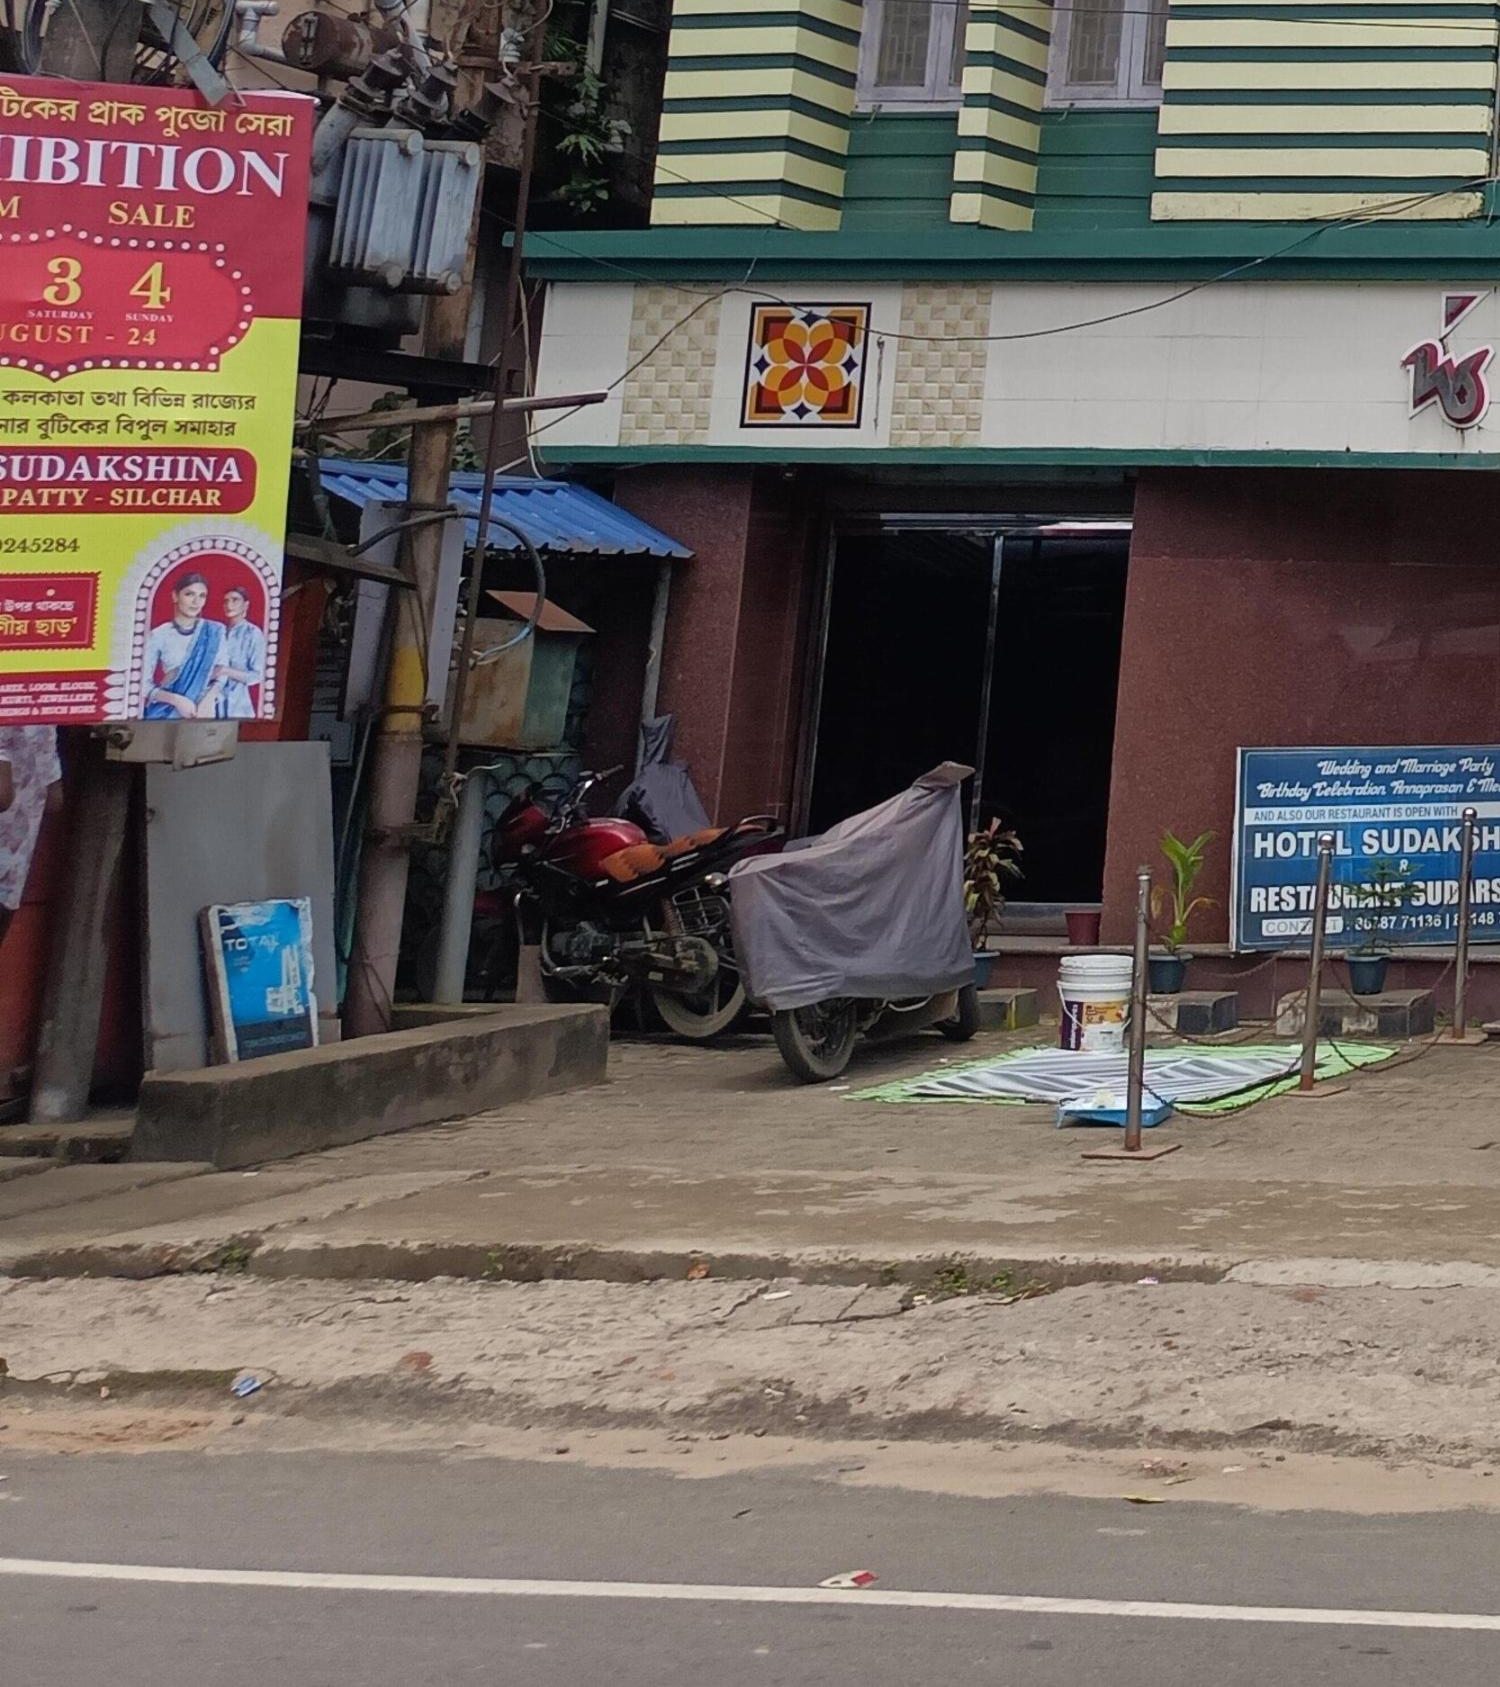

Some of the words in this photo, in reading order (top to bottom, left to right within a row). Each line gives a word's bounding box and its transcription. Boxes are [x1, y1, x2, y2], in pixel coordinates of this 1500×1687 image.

[88, 100, 146, 126] প্রাক
[155, 107, 227, 138] পুজো
[235, 112, 294, 137] সেরা
[0, 134, 290, 198] IBITION
[108, 201, 195, 229] SALE
[43, 257, 82, 306] 3
[129, 261, 171, 310] 4
[28, 309, 94, 320] SATURDAY
[125, 313, 174, 323] SUNDAY
[127, 327, 157, 346] 24
[3, 390, 84, 407] কলকাতা
[91, 391, 127, 407] তথা
[133, 387, 186, 409] বিভিন্ন
[192, 393, 256, 410] রাজ্যের
[37, 413, 110, 440] বুটিকের
[116, 414, 167, 441] বিপুল
[174, 420, 237, 437] সমাহার
[1, 488, 88, 506] PATTY
[110, 488, 221, 507] SILCHAR
[0, 537, 80, 553] 245284
[1317, 759, 1372, 779] Wedding
[1375, 758, 1401, 774] and
[1400, 758, 1456, 778] Marriage
[1459, 756, 1495, 776] Party
[1257, 781, 1312, 801] Birthday
[1254, 811, 1275, 822] AND
[1277, 810, 1302, 821] ALSO
[1305, 809, 1326, 820] OUR
[1328, 807, 1391, 820] RESTAURANT
[1393, 807, 1403, 818] IS
[1405, 807, 1431, 818] OPEN
[1433, 806, 1458, 816] WITH
[224, 935, 278, 951] TOTAL
